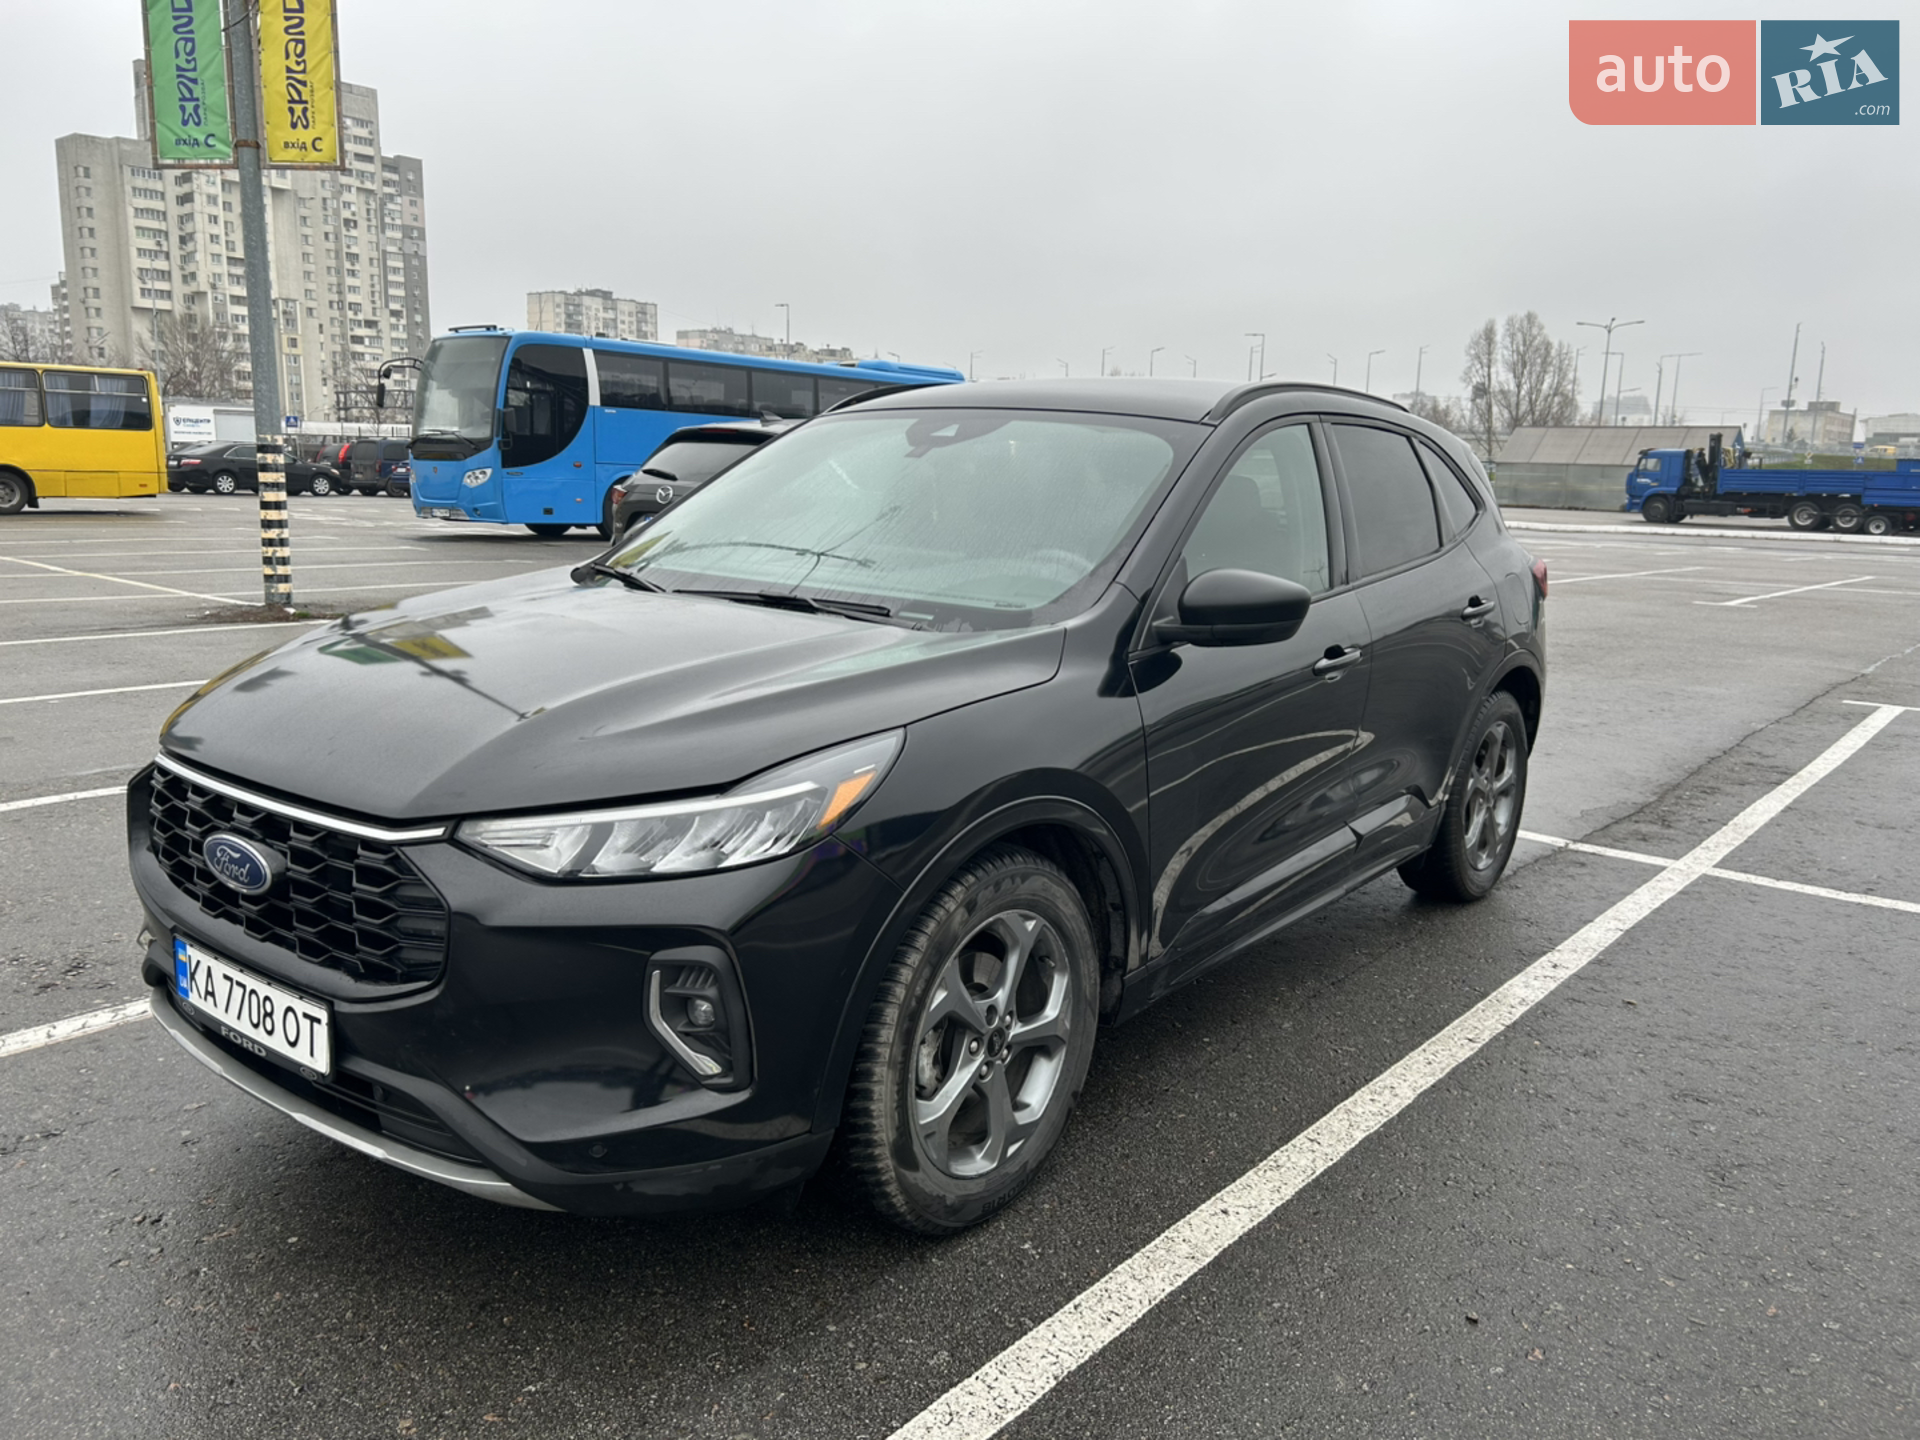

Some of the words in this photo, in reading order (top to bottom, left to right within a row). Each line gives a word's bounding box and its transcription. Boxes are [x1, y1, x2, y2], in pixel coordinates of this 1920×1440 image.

[175, 135, 200, 148] вхід
[284, 138, 308, 152] вхід
[214, 845, 250, 883] Ford
[188, 954, 218, 1009] KA
[222, 973, 275, 1036] 7708
[282, 1005, 322, 1058] OT
[221, 1025, 267, 1057] FORD
